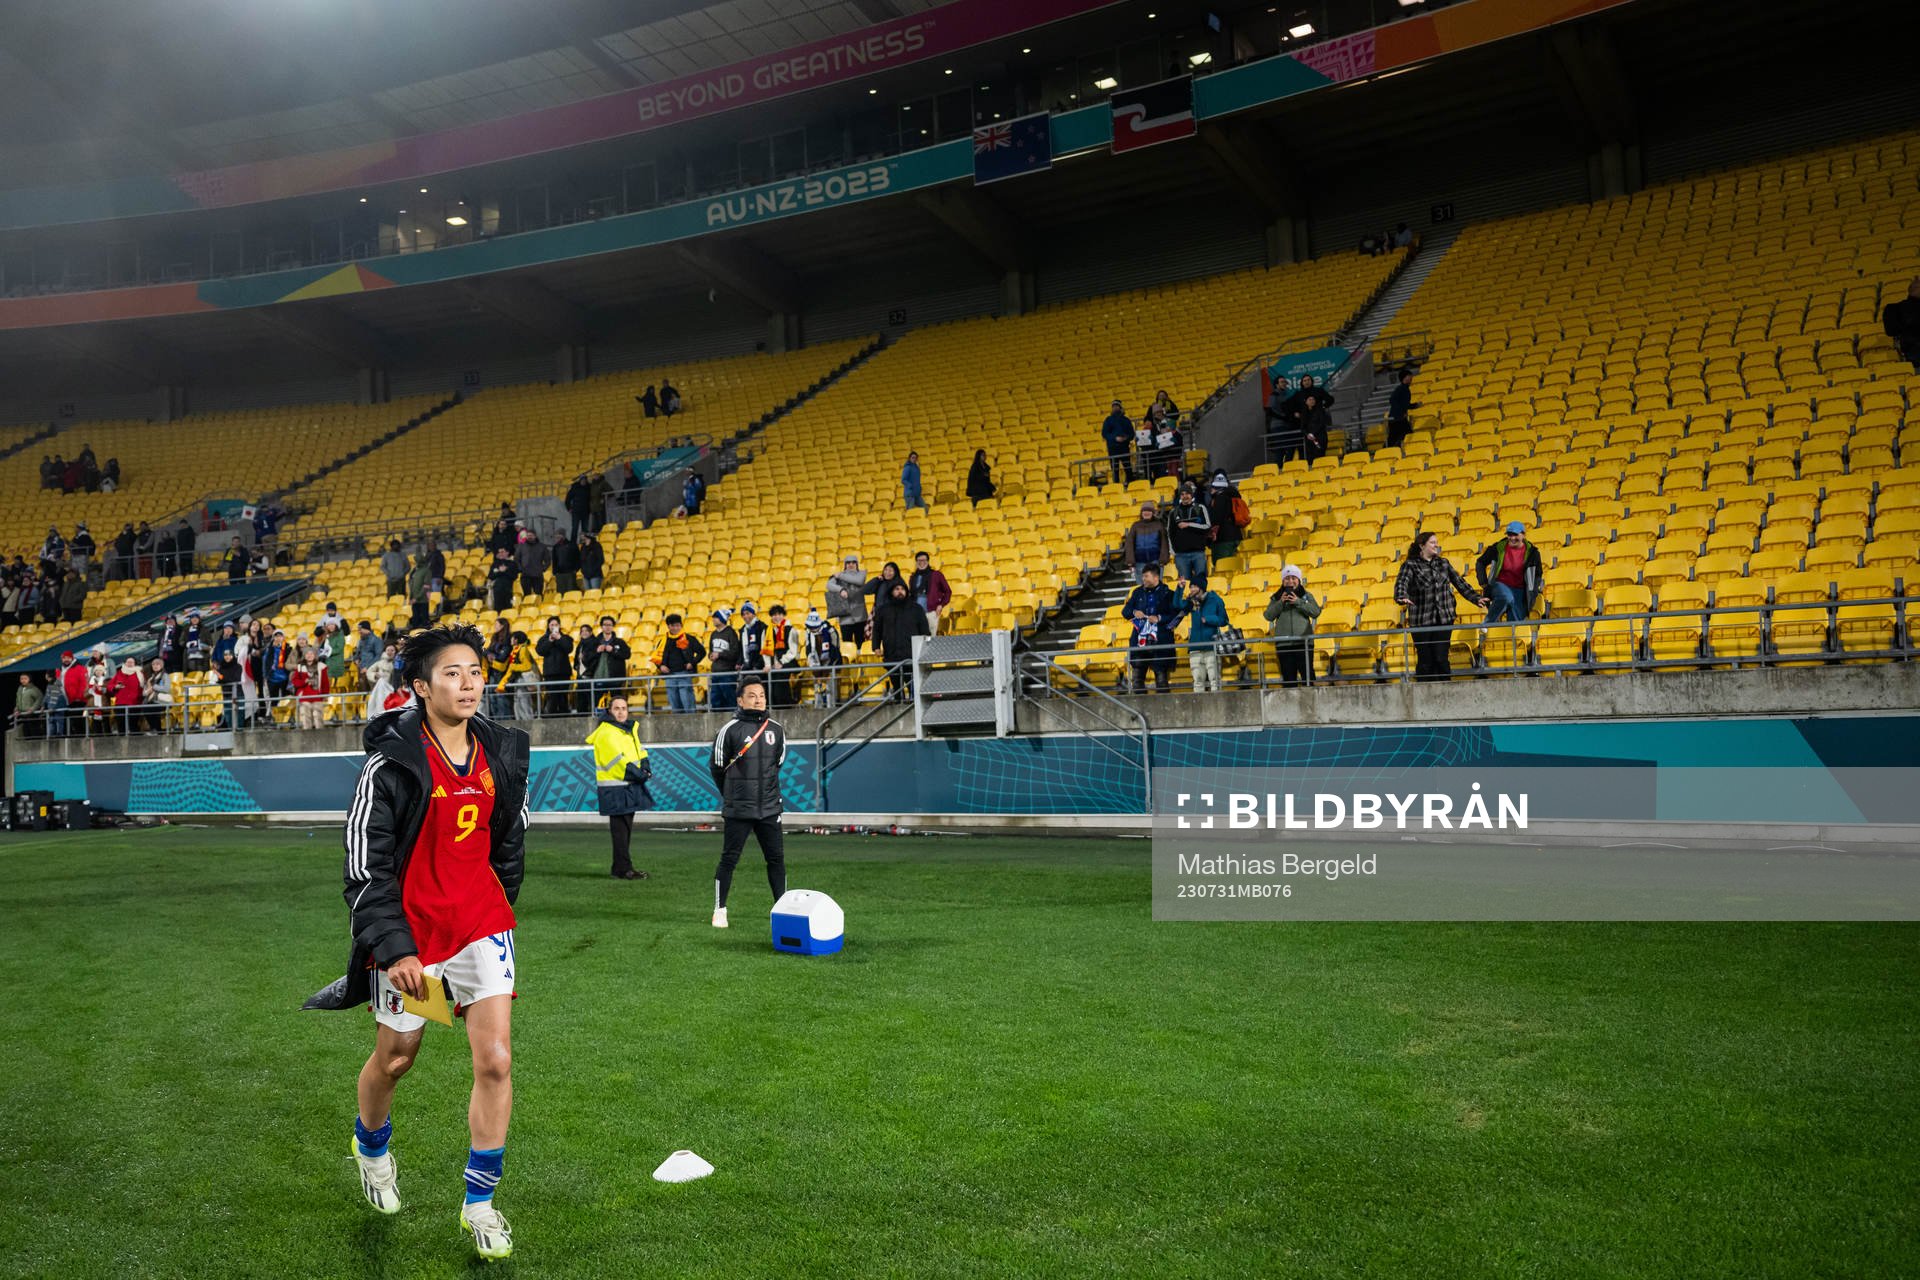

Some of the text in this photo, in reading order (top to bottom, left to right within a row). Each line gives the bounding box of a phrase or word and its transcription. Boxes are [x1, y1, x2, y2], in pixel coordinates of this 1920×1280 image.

[638, 74, 745, 121] BEYOND
[1433, 204, 1452, 221] 31
[454, 803, 479, 843] 9
